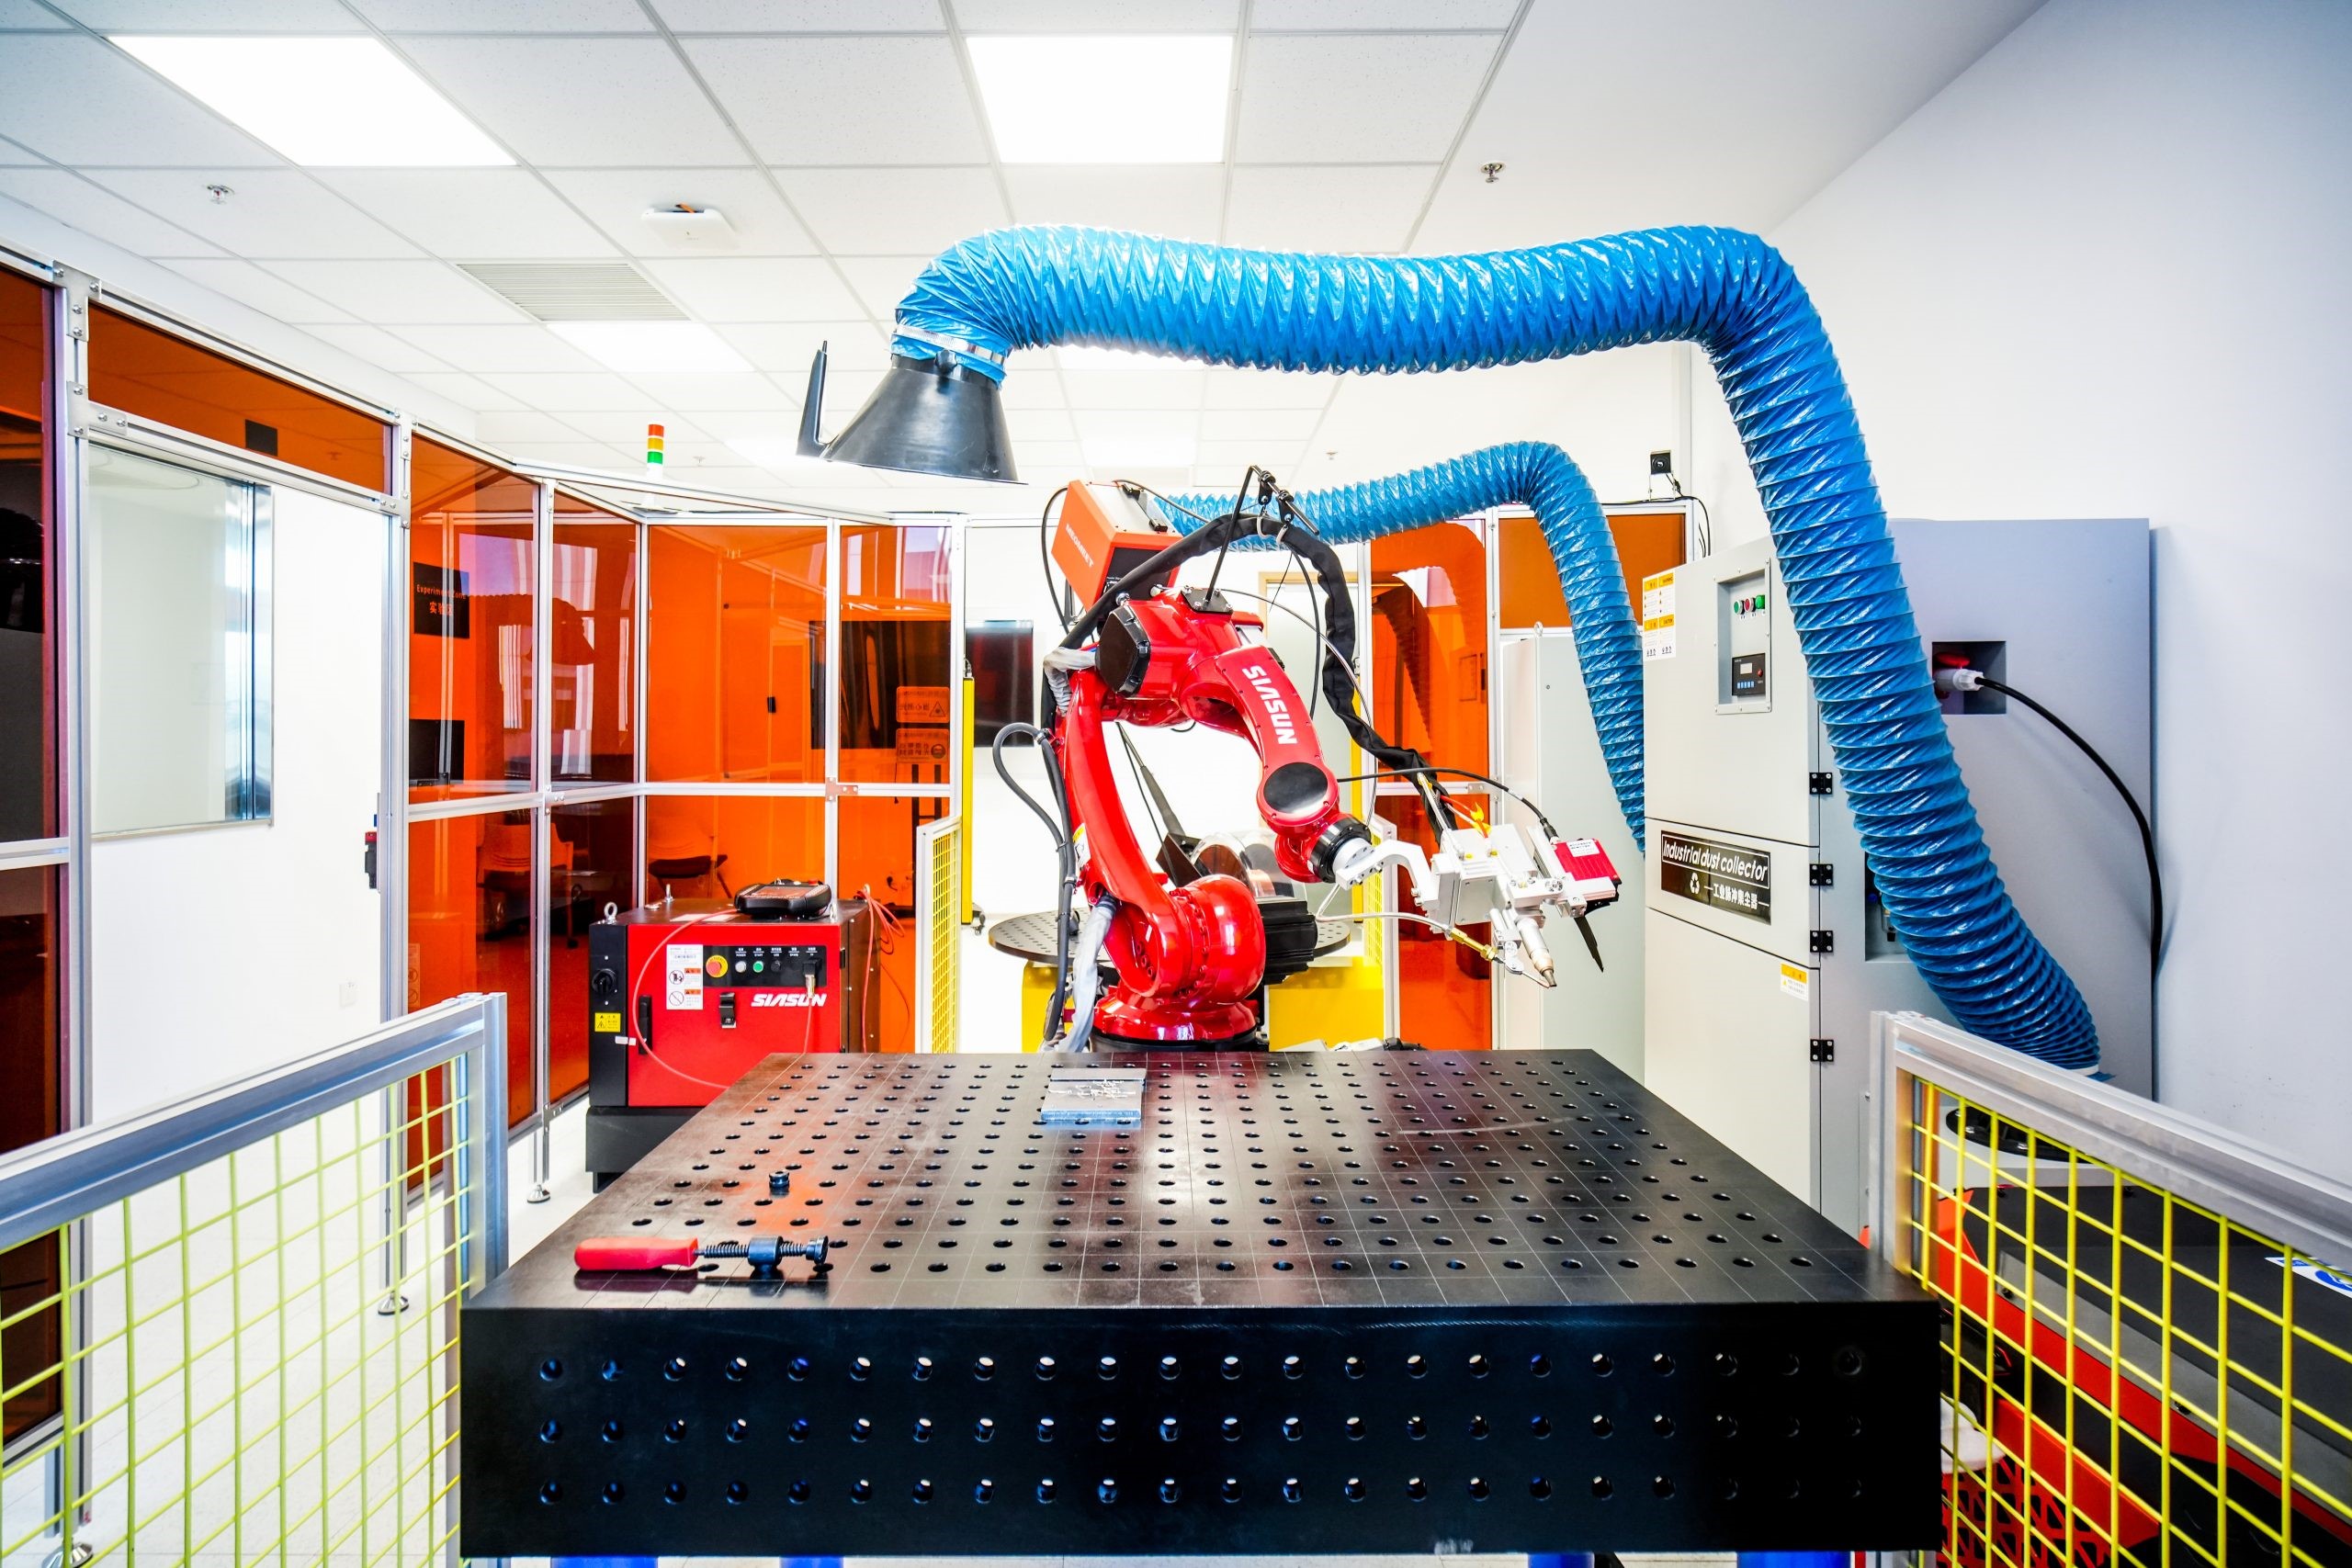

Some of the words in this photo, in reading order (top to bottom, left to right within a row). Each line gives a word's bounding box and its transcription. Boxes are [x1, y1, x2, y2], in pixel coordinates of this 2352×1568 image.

[1241, 664, 1298, 745] SIASUN
[1663, 840, 1702, 864] Industrial
[1701, 848, 1721, 870] dust
[1721, 856, 1768, 881] collector
[751, 993, 827, 1008] SIASUN
